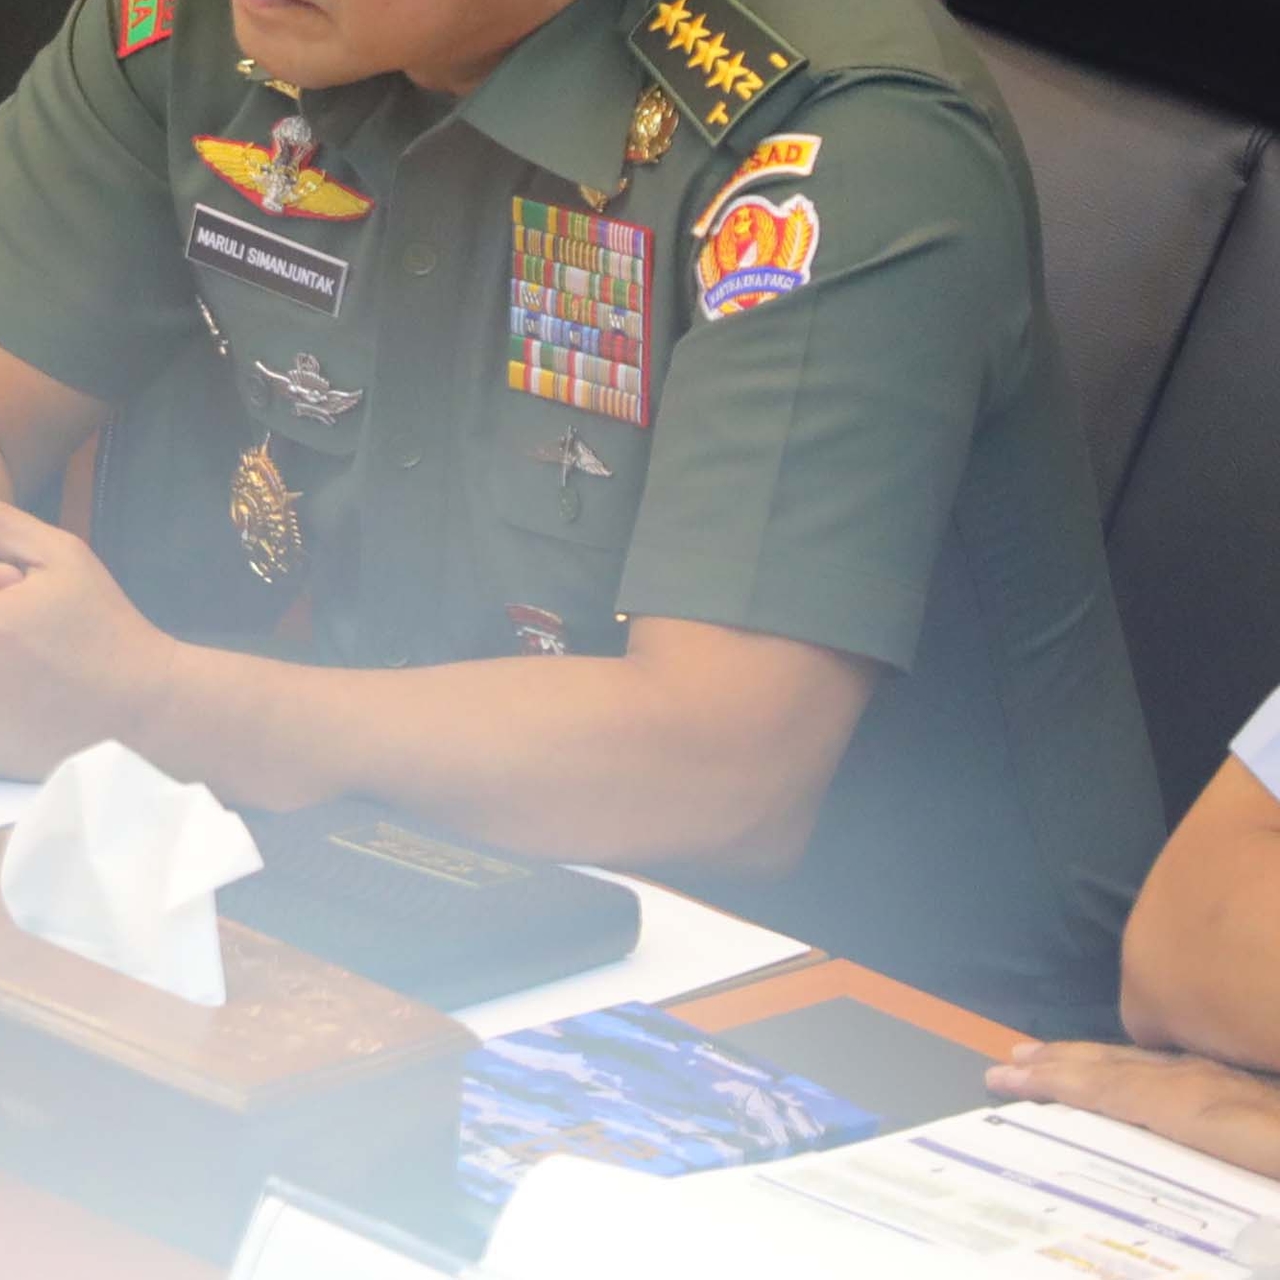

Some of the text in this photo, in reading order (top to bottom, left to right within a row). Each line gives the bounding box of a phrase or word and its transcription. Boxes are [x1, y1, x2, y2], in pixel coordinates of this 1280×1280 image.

[705, 50, 789, 126] TNI
[197, 226, 336, 297] MARULI SIMANJUNTAK
